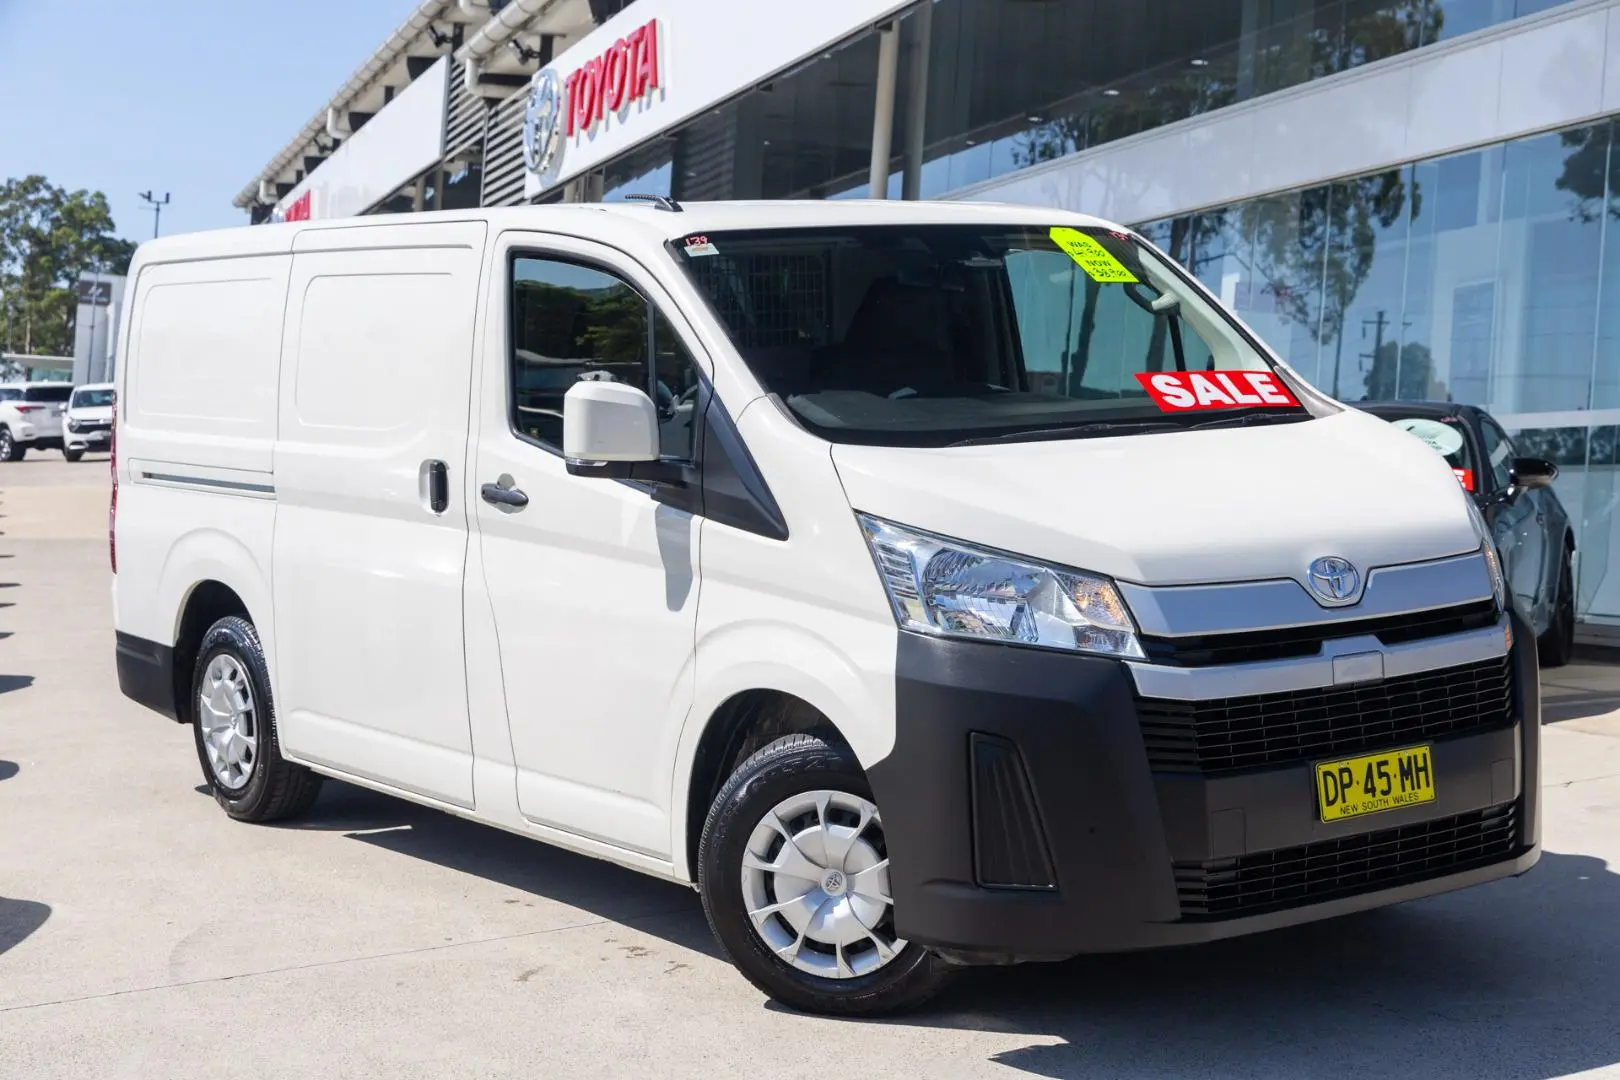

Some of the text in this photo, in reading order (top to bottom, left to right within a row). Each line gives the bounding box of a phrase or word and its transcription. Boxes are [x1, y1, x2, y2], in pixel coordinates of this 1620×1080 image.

[565, 18, 657, 136] TOYOTA
[685, 236, 708, 248] 139
[1150, 373, 1290, 408] SALE
[1340, 792, 1420, 815] NEW SOUTH WALES
